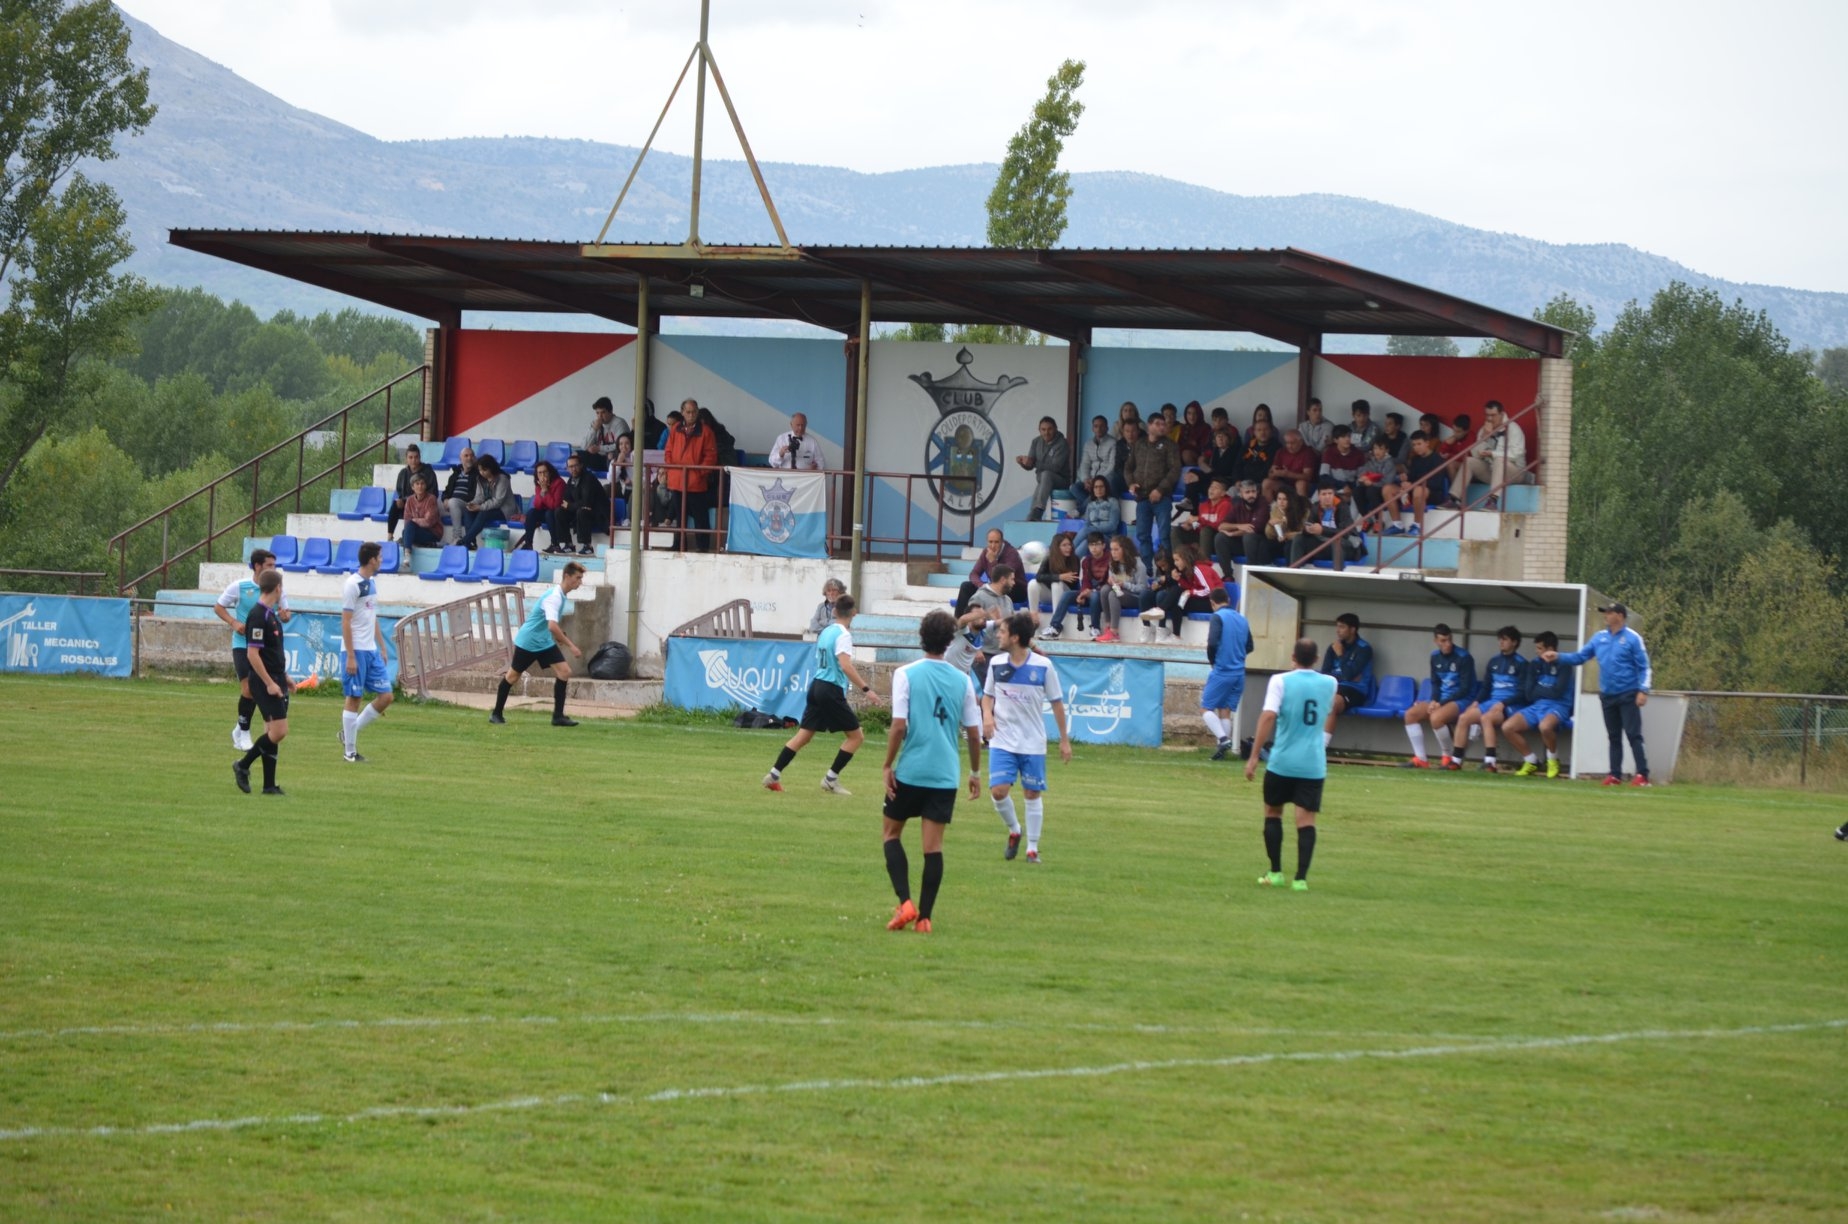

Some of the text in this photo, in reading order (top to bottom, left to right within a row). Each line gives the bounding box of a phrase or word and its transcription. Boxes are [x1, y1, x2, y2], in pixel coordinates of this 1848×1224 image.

[941, 391, 984, 406] CLUB
[942, 492, 984, 508] ALAS
[22, 621, 57, 631] TALLER
[44, 638, 99, 649] MECANICO
[61, 655, 118, 666] ROSCALES
[933, 696, 948, 726] 4
[1303, 699, 1318, 726] 6
